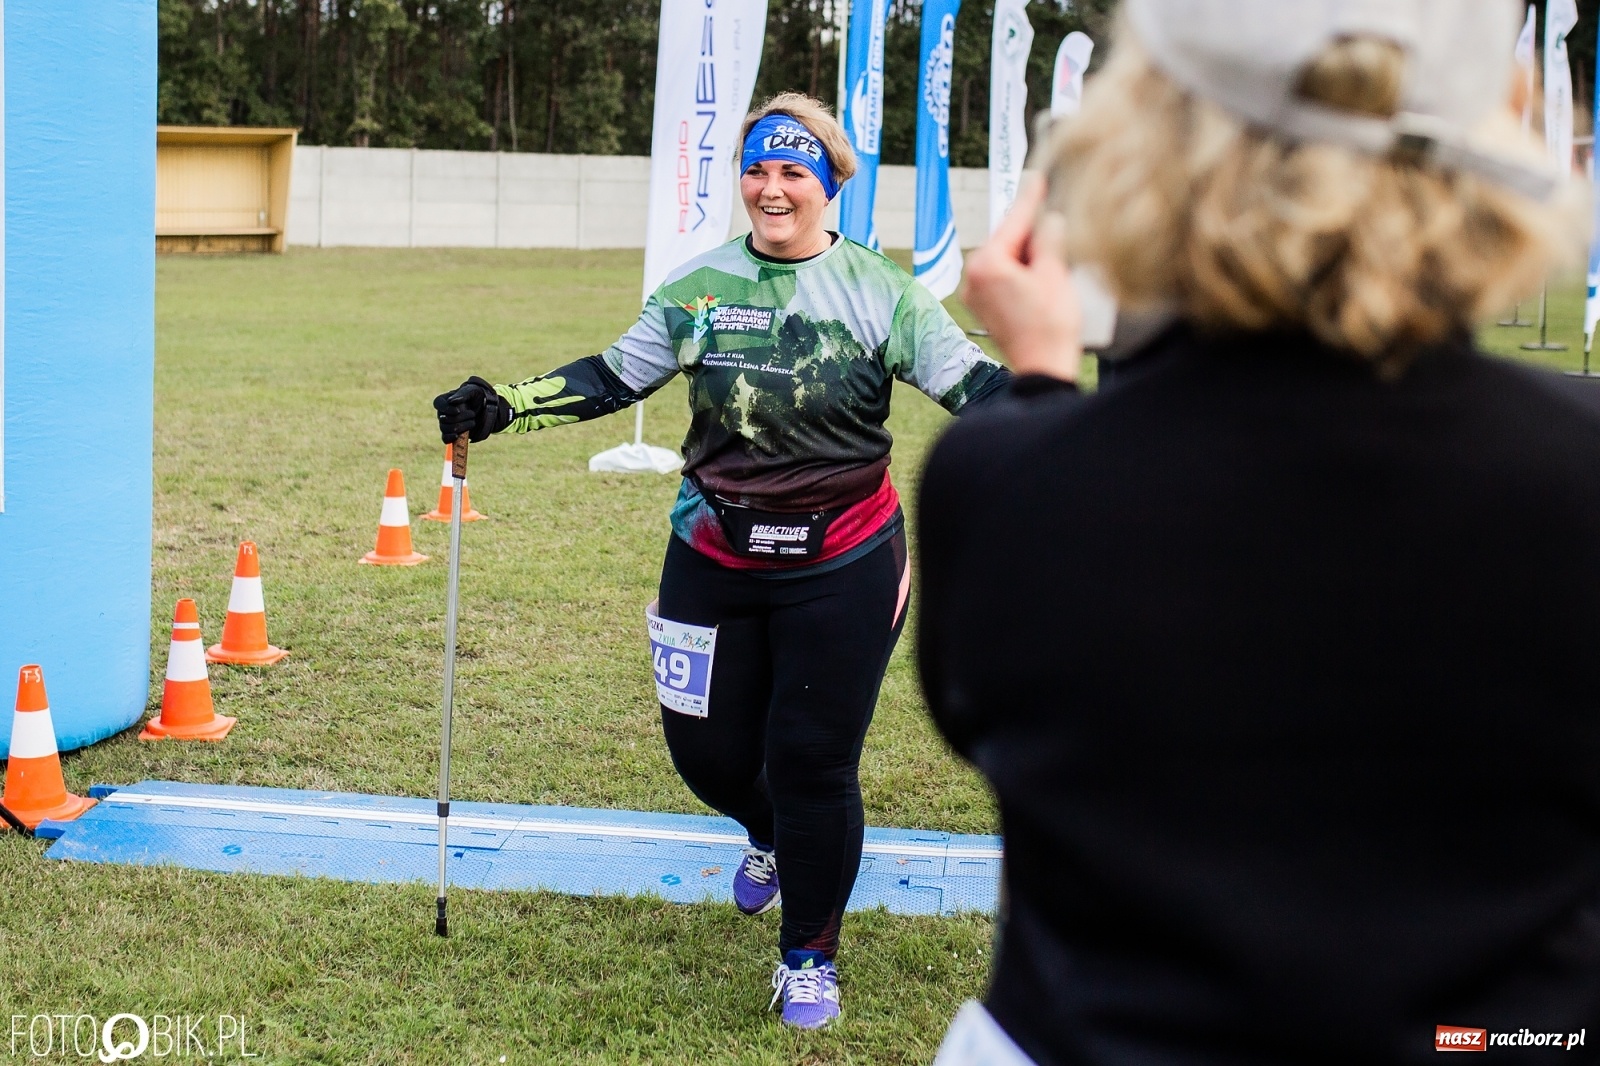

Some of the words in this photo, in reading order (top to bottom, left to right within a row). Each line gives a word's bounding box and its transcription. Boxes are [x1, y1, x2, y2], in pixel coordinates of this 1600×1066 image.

[692, 0, 717, 232] VANES
[677, 120, 690, 233] RADIO
[653, 646, 691, 690] 49
